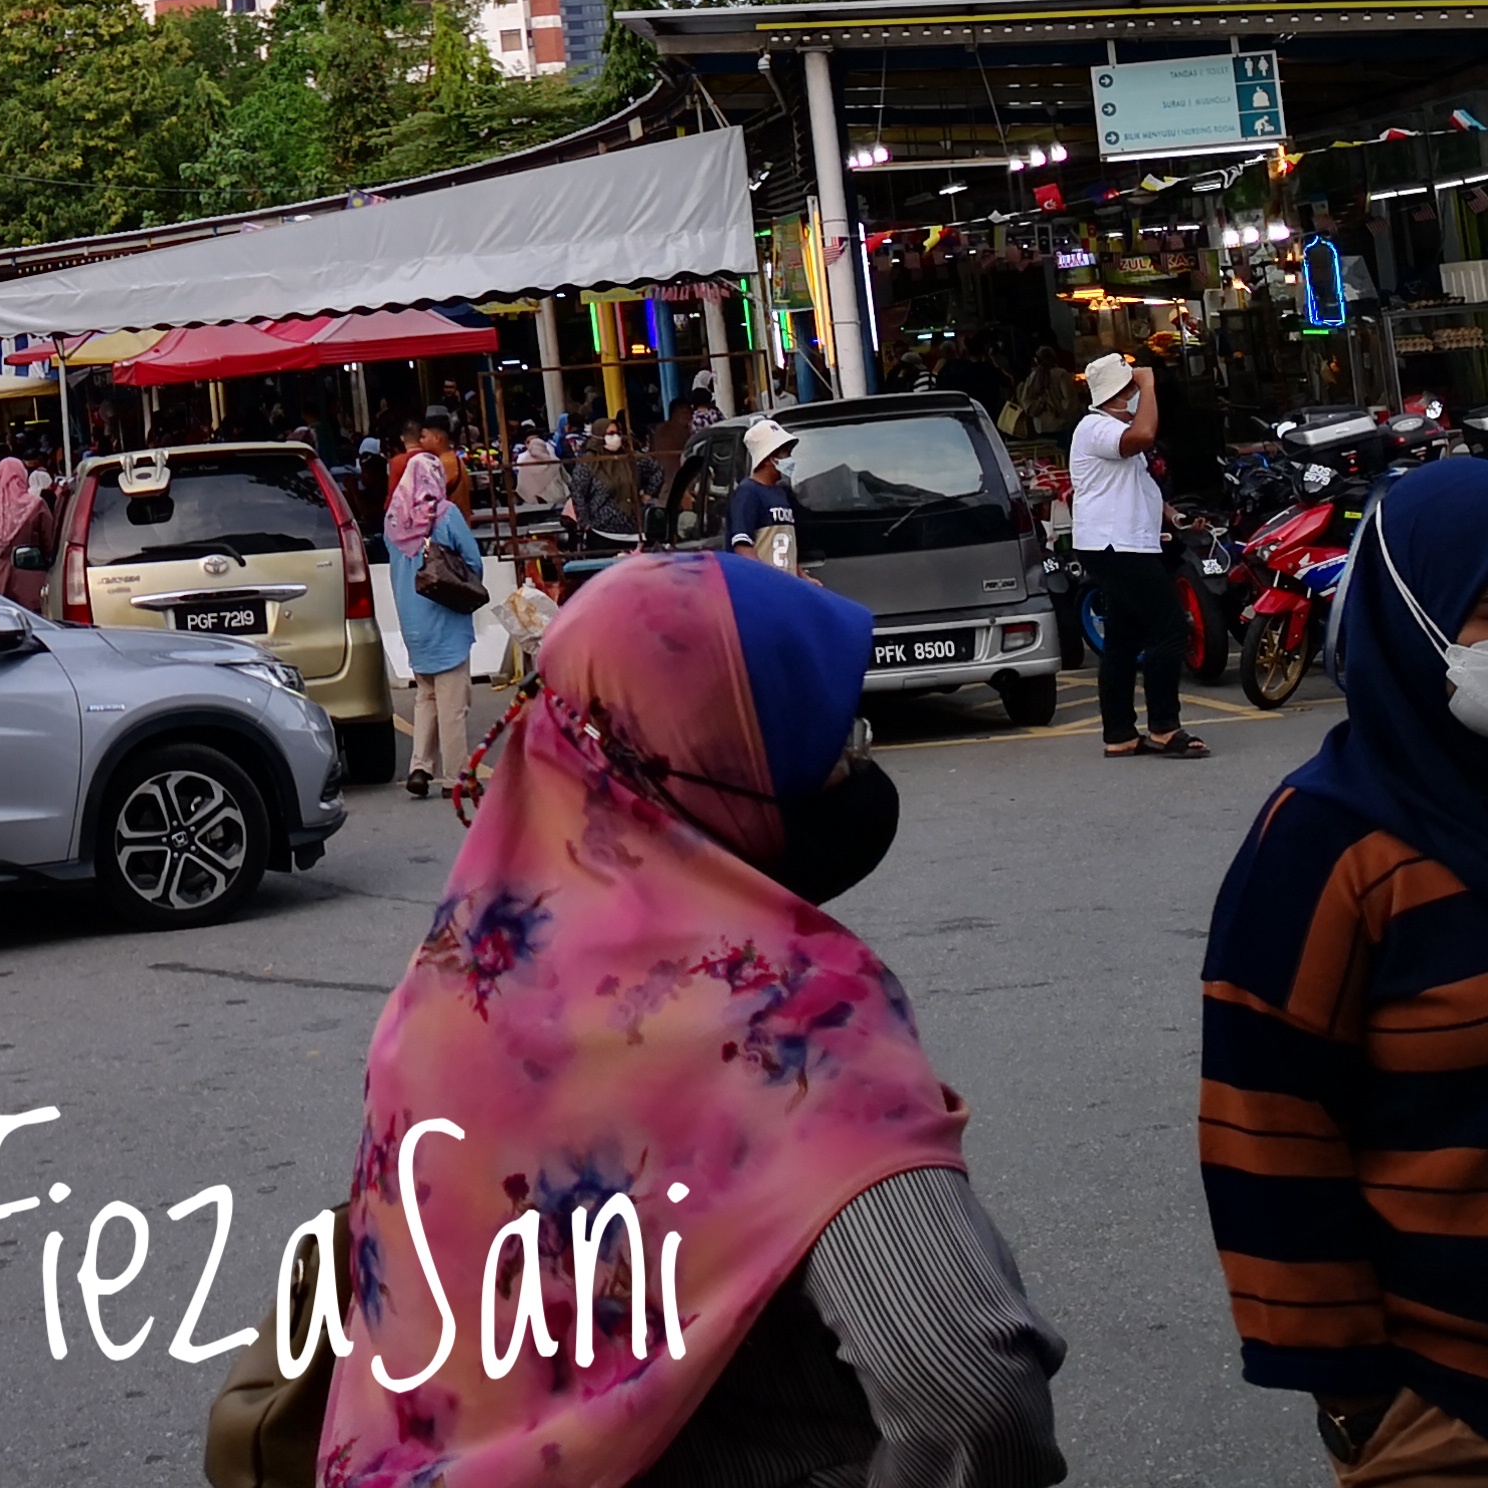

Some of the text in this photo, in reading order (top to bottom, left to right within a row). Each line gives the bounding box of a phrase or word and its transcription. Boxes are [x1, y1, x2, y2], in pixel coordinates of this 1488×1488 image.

[1170, 70, 1197, 78] TANDAS
[1162, 100, 1186, 109] SURAU
[1124, 132, 1141, 141] BILIK
[187, 609, 255, 630] PGF 7219
[874, 640, 955, 663] PFK 8500
